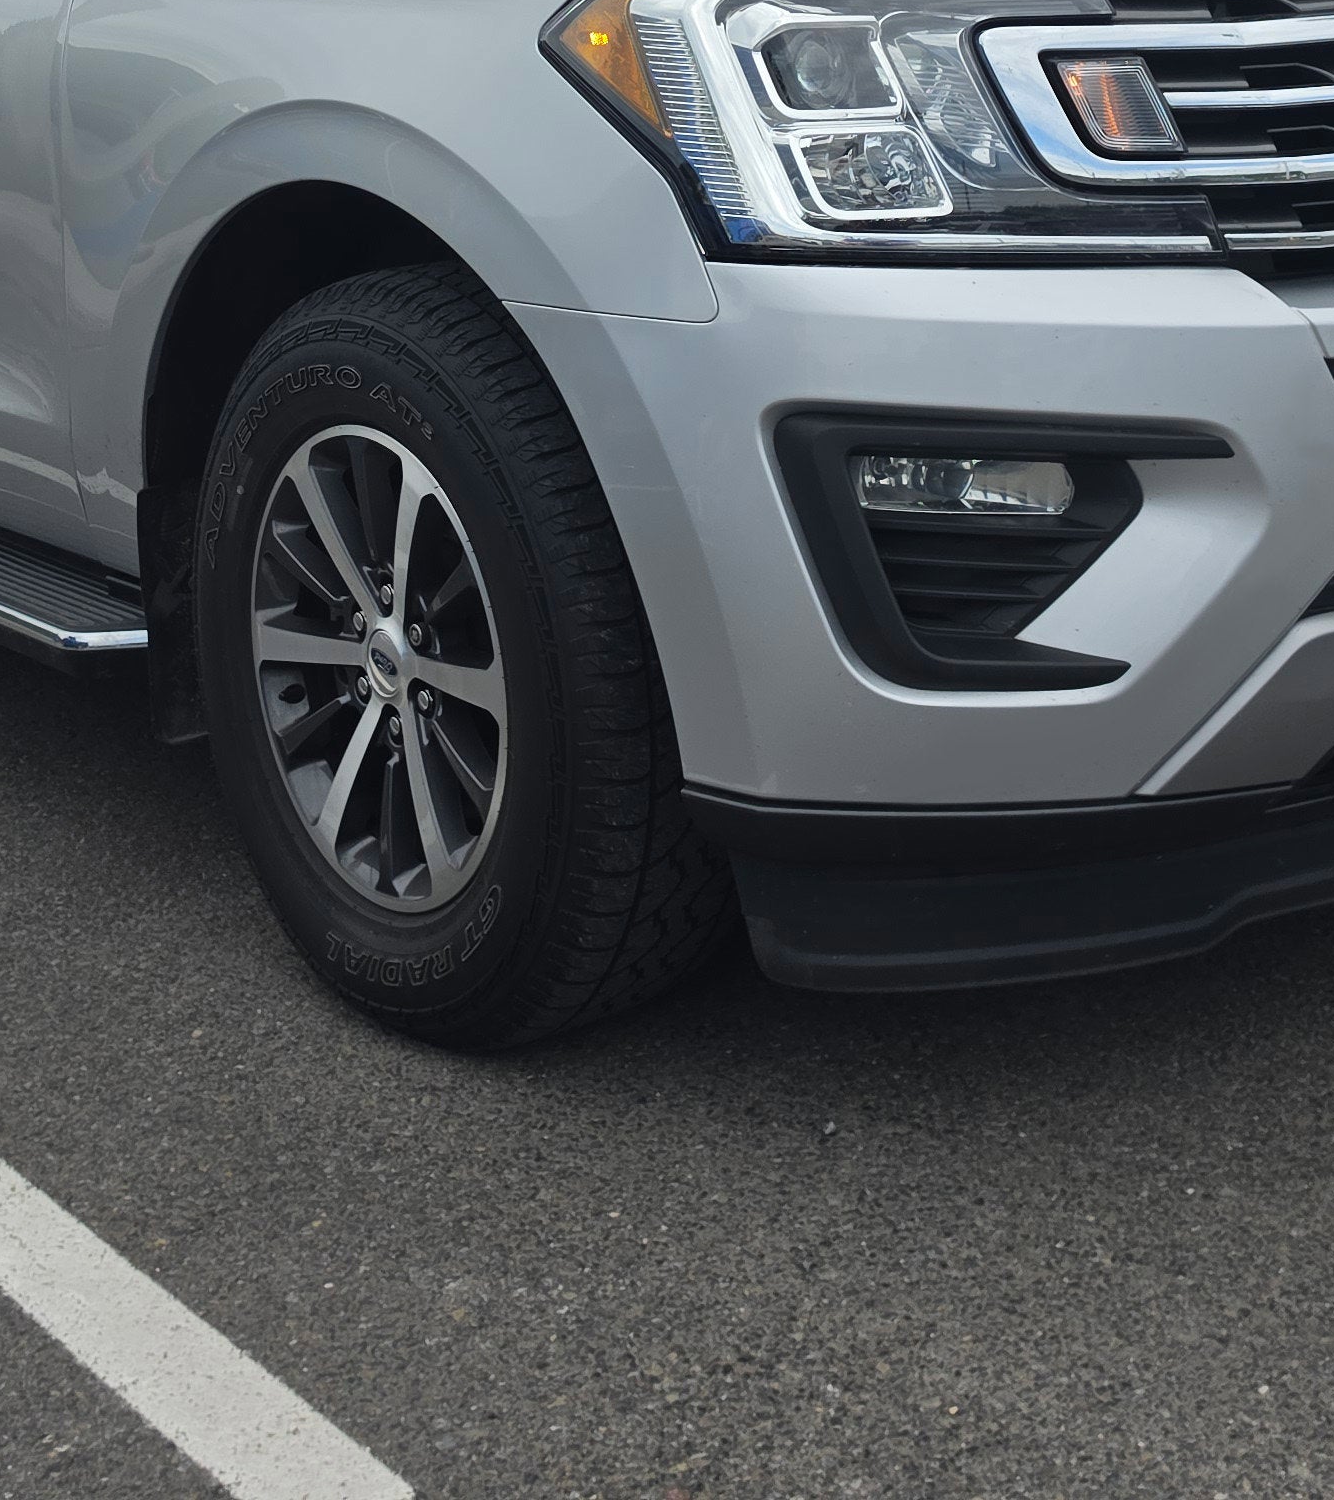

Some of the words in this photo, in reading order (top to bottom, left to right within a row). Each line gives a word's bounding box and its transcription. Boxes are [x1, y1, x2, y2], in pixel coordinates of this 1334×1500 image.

[203, 364, 363, 571] ADVENTURO
[326, 931, 455, 987] RADIAL
[461, 884, 502, 963] GT
